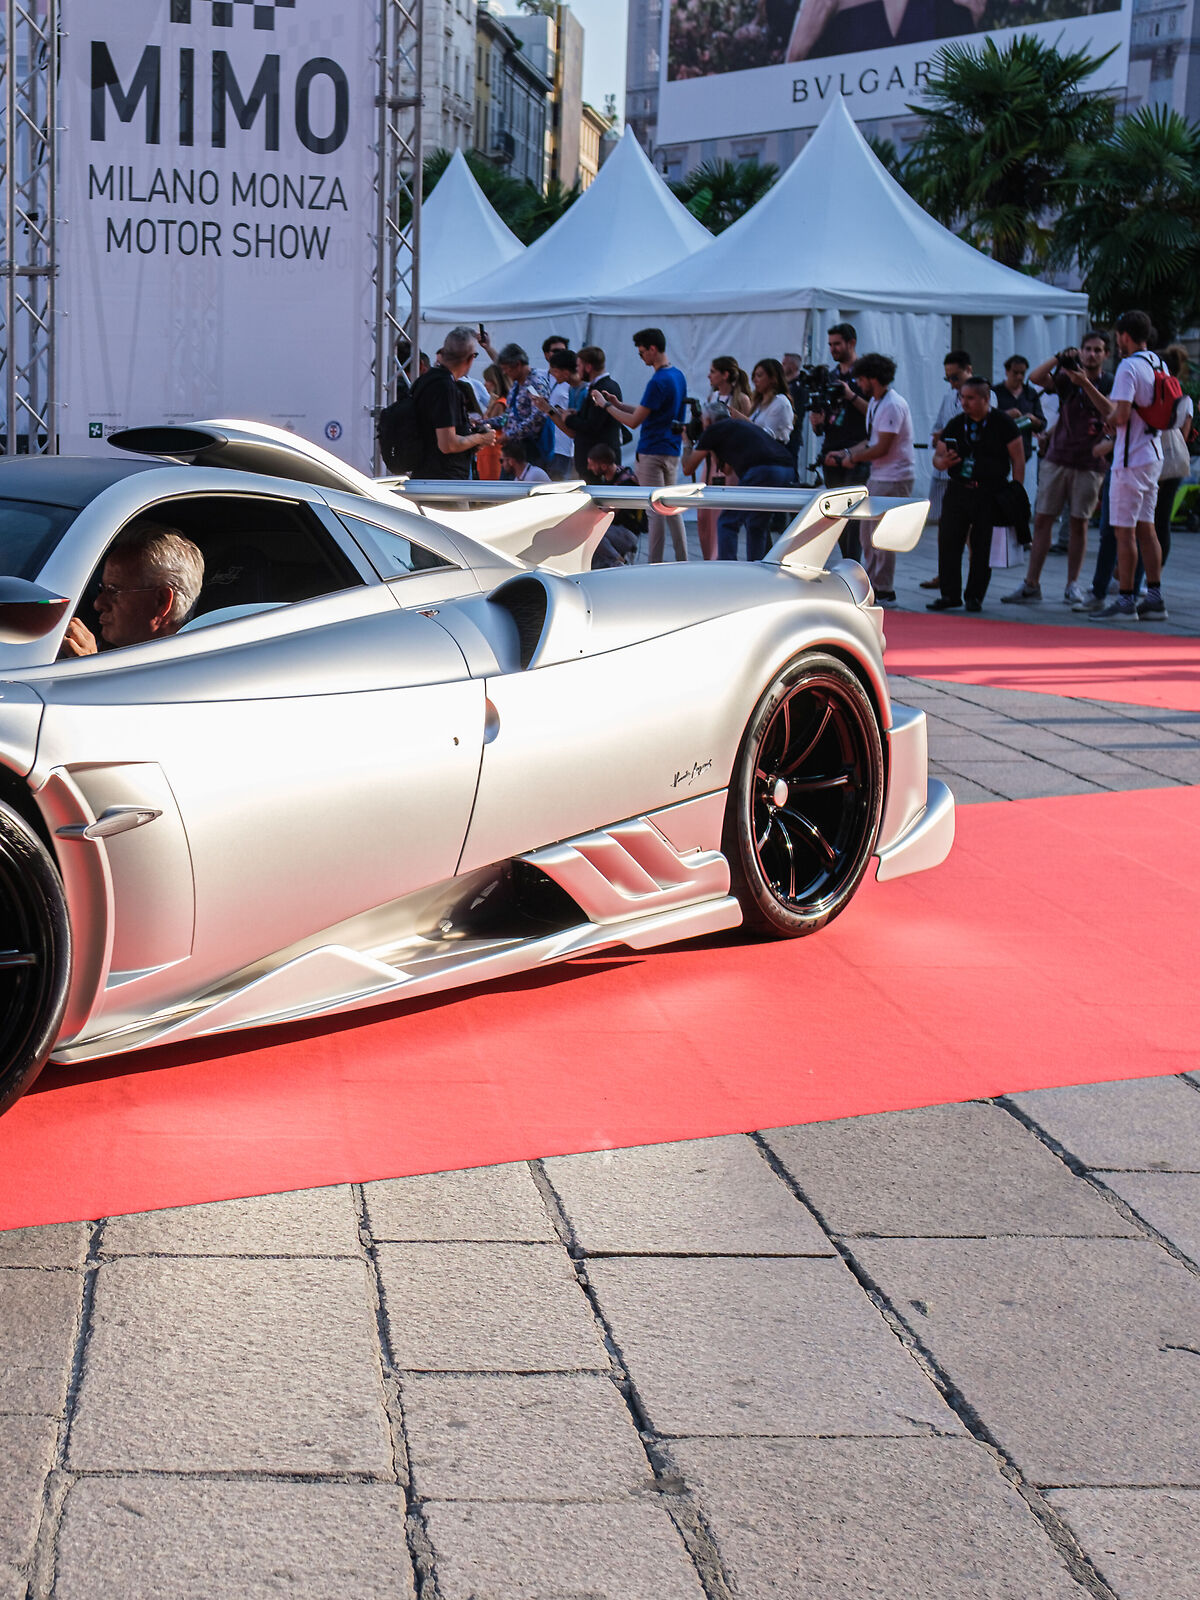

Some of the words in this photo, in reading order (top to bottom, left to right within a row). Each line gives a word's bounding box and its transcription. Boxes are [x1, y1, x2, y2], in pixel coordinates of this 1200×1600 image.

[90, 41, 349, 155] MIMO
[792, 60, 931, 103] BVLGAR
[89, 164, 219, 205] MILANO
[232, 171, 348, 211] MONZA
[106, 217, 222, 256] MOTOR
[232, 222, 331, 260] SHOW
